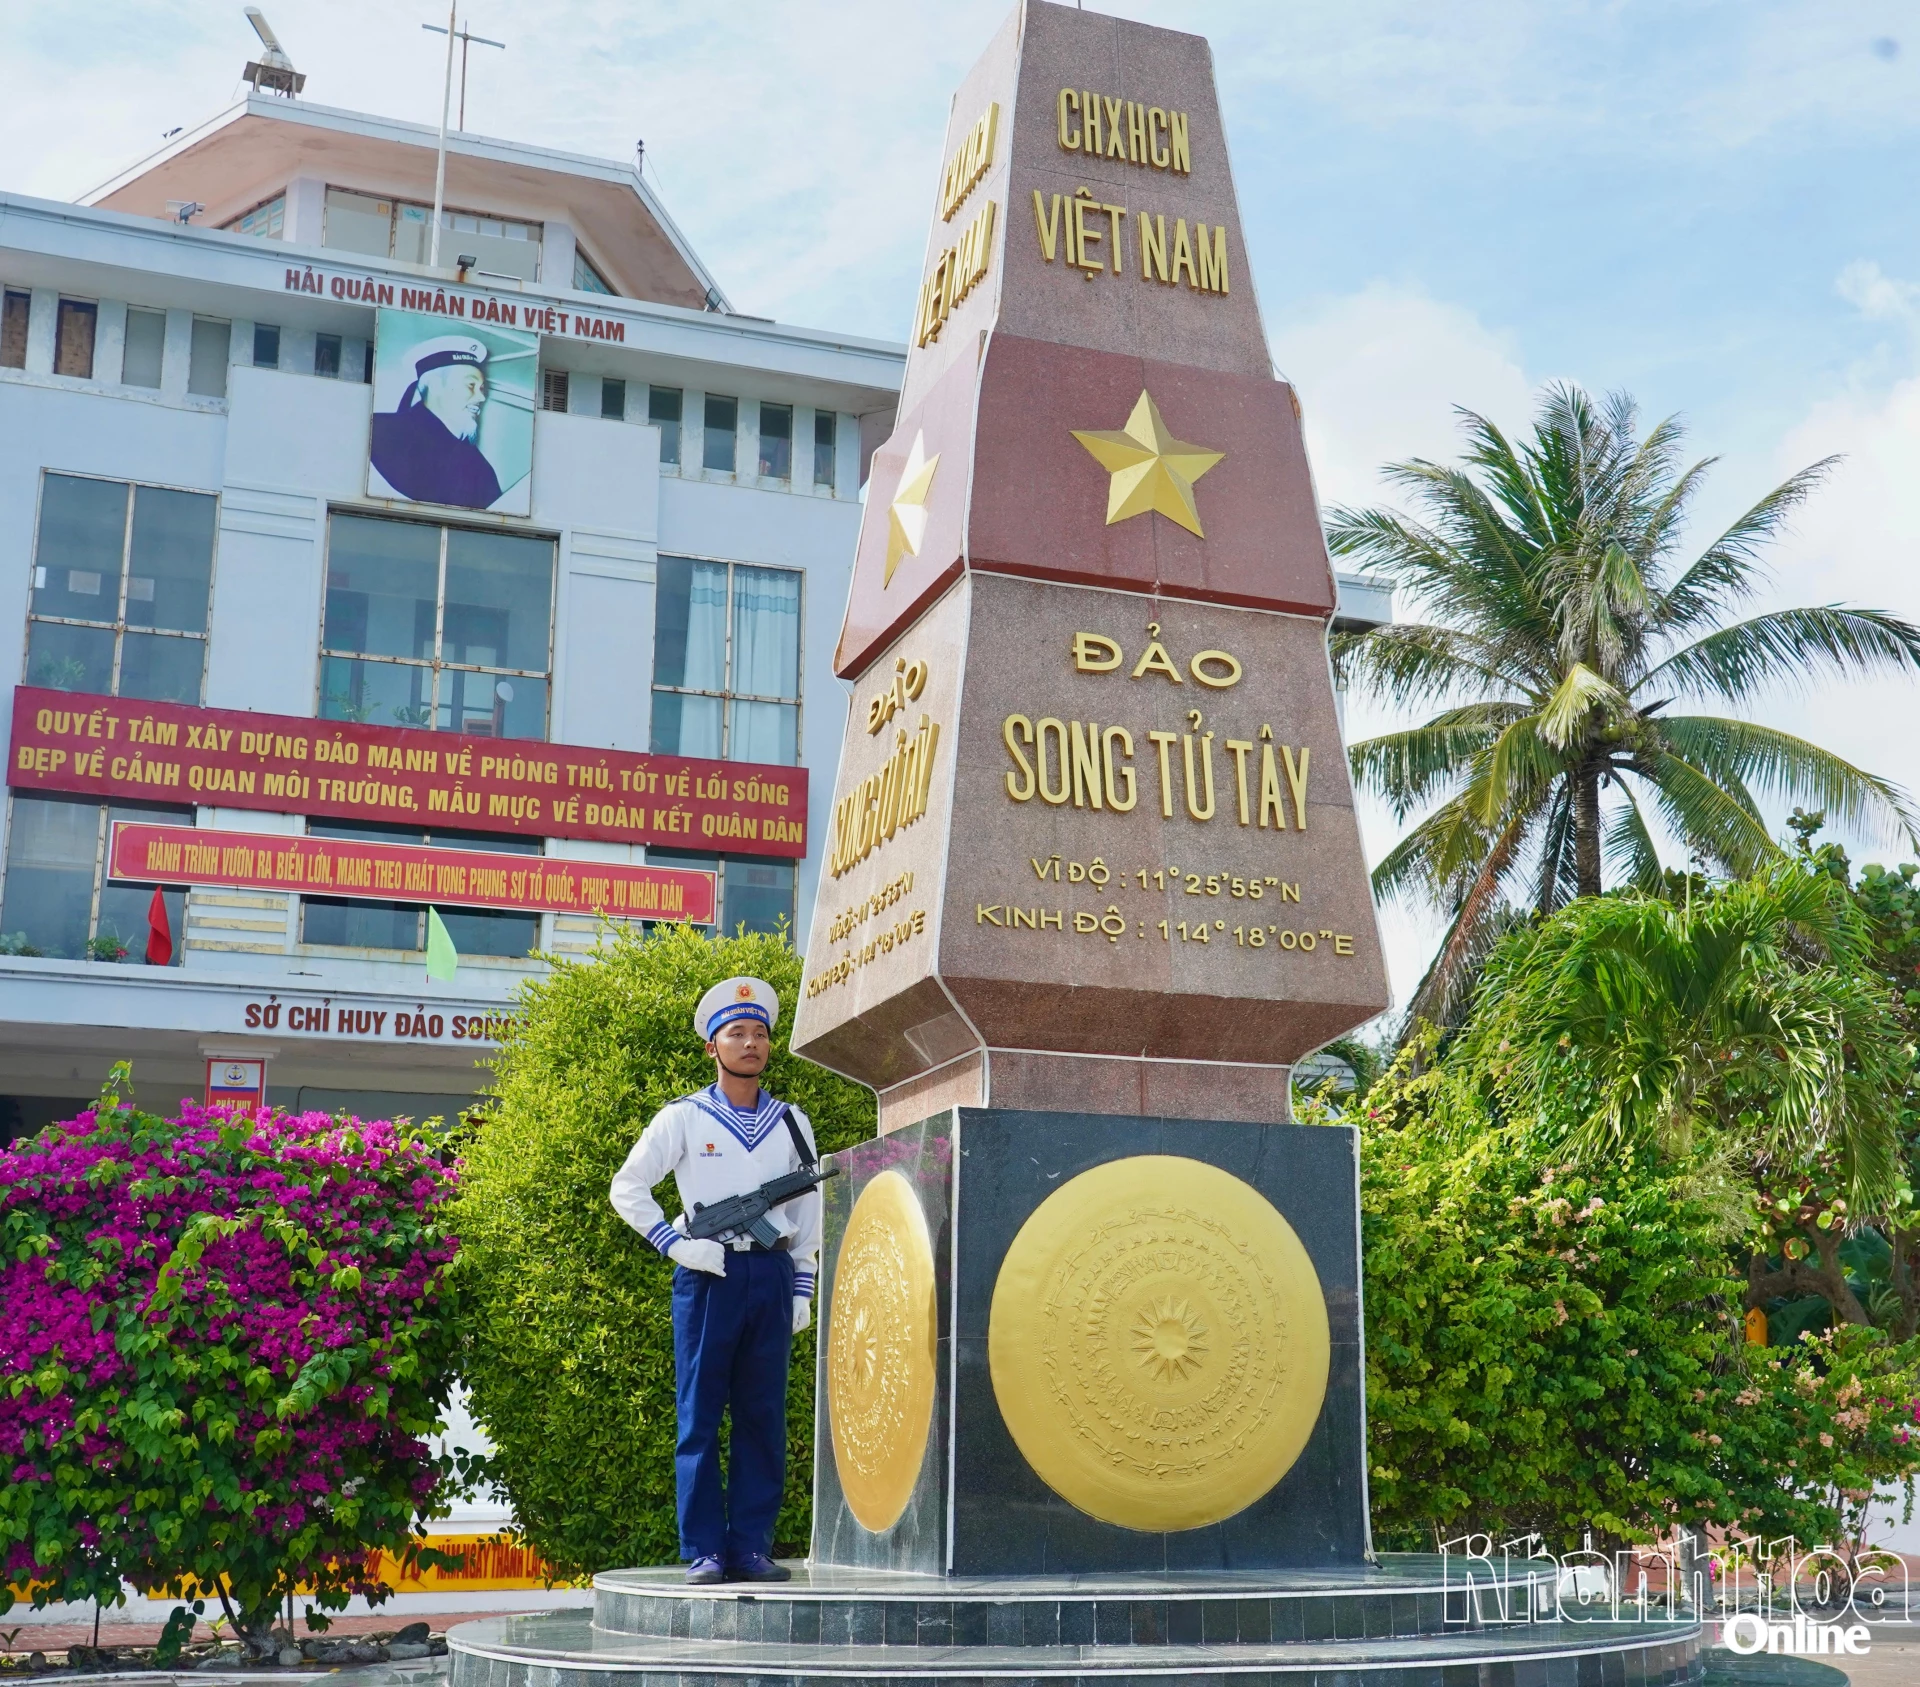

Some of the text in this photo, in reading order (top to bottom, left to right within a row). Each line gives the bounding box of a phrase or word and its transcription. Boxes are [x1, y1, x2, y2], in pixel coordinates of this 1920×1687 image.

[1057, 87, 1191, 173] CHXHCN
[917, 199, 995, 349] VIỆT NAM
[1033, 185, 1230, 296] VIỆT NAM
[285, 265, 626, 342] HẢI QUÂN NHÂN DÂN VIỆT NAM
[1072, 622, 1243, 688] ĐẢO
[866, 656, 928, 736] ĐẢO
[17, 745, 803, 844] ĐẸP VỀ CẢNH QUAN MÔI TRƯỜNG, MẪU MỰC VỀ ĐOÀN KẾT QUÂN DÂN
[37, 708, 789, 806] QUYẾT TÂM XÂY DỰNG ĐẢO MẠNH VỀ PHÒNG THỦ, TỐT VỀ LỐI SỐNG
[1003, 709, 1310, 830] SONG TỬ TÂY
[830, 773, 880, 879] SONG
[146, 841, 182, 872] HÀNH
[184, 840, 219, 875] TRÌNH
[222, 849, 254, 878] VƯƠN
[257, 850, 272, 879] RA
[276, 842, 305, 882] BIỂN
[307, 849, 333, 887] LỚN,
[337, 856, 371, 887] MANG
[375, 859, 402, 890] THEO
[404, 858, 435, 892] KHÁT
[436, 866, 466, 897] VỌNG
[469, 870, 507, 901] PHỤNG
[510, 871, 528, 903] SỰ
[529, 862, 544, 901] TỔ
[545, 865, 578, 908] QUỐC,
[613, 880, 627, 911] VỤ
[629, 877, 658, 910] NHÂN
[661, 879, 684, 912] DÂN
[1030, 854, 1060, 882] VĨ
[1068, 856, 1110, 892] ĐỘ
[976, 903, 1064, 932] KINH
[1073, 906, 1127, 942] ĐỘ
[245, 994, 282, 1028] SỞ
[288, 998, 331, 1032] CHỈ
[338, 1010, 387, 1035] HUY
[395, 1004, 444, 1038] ĐẢO
[806, 970, 833, 999] KINH
